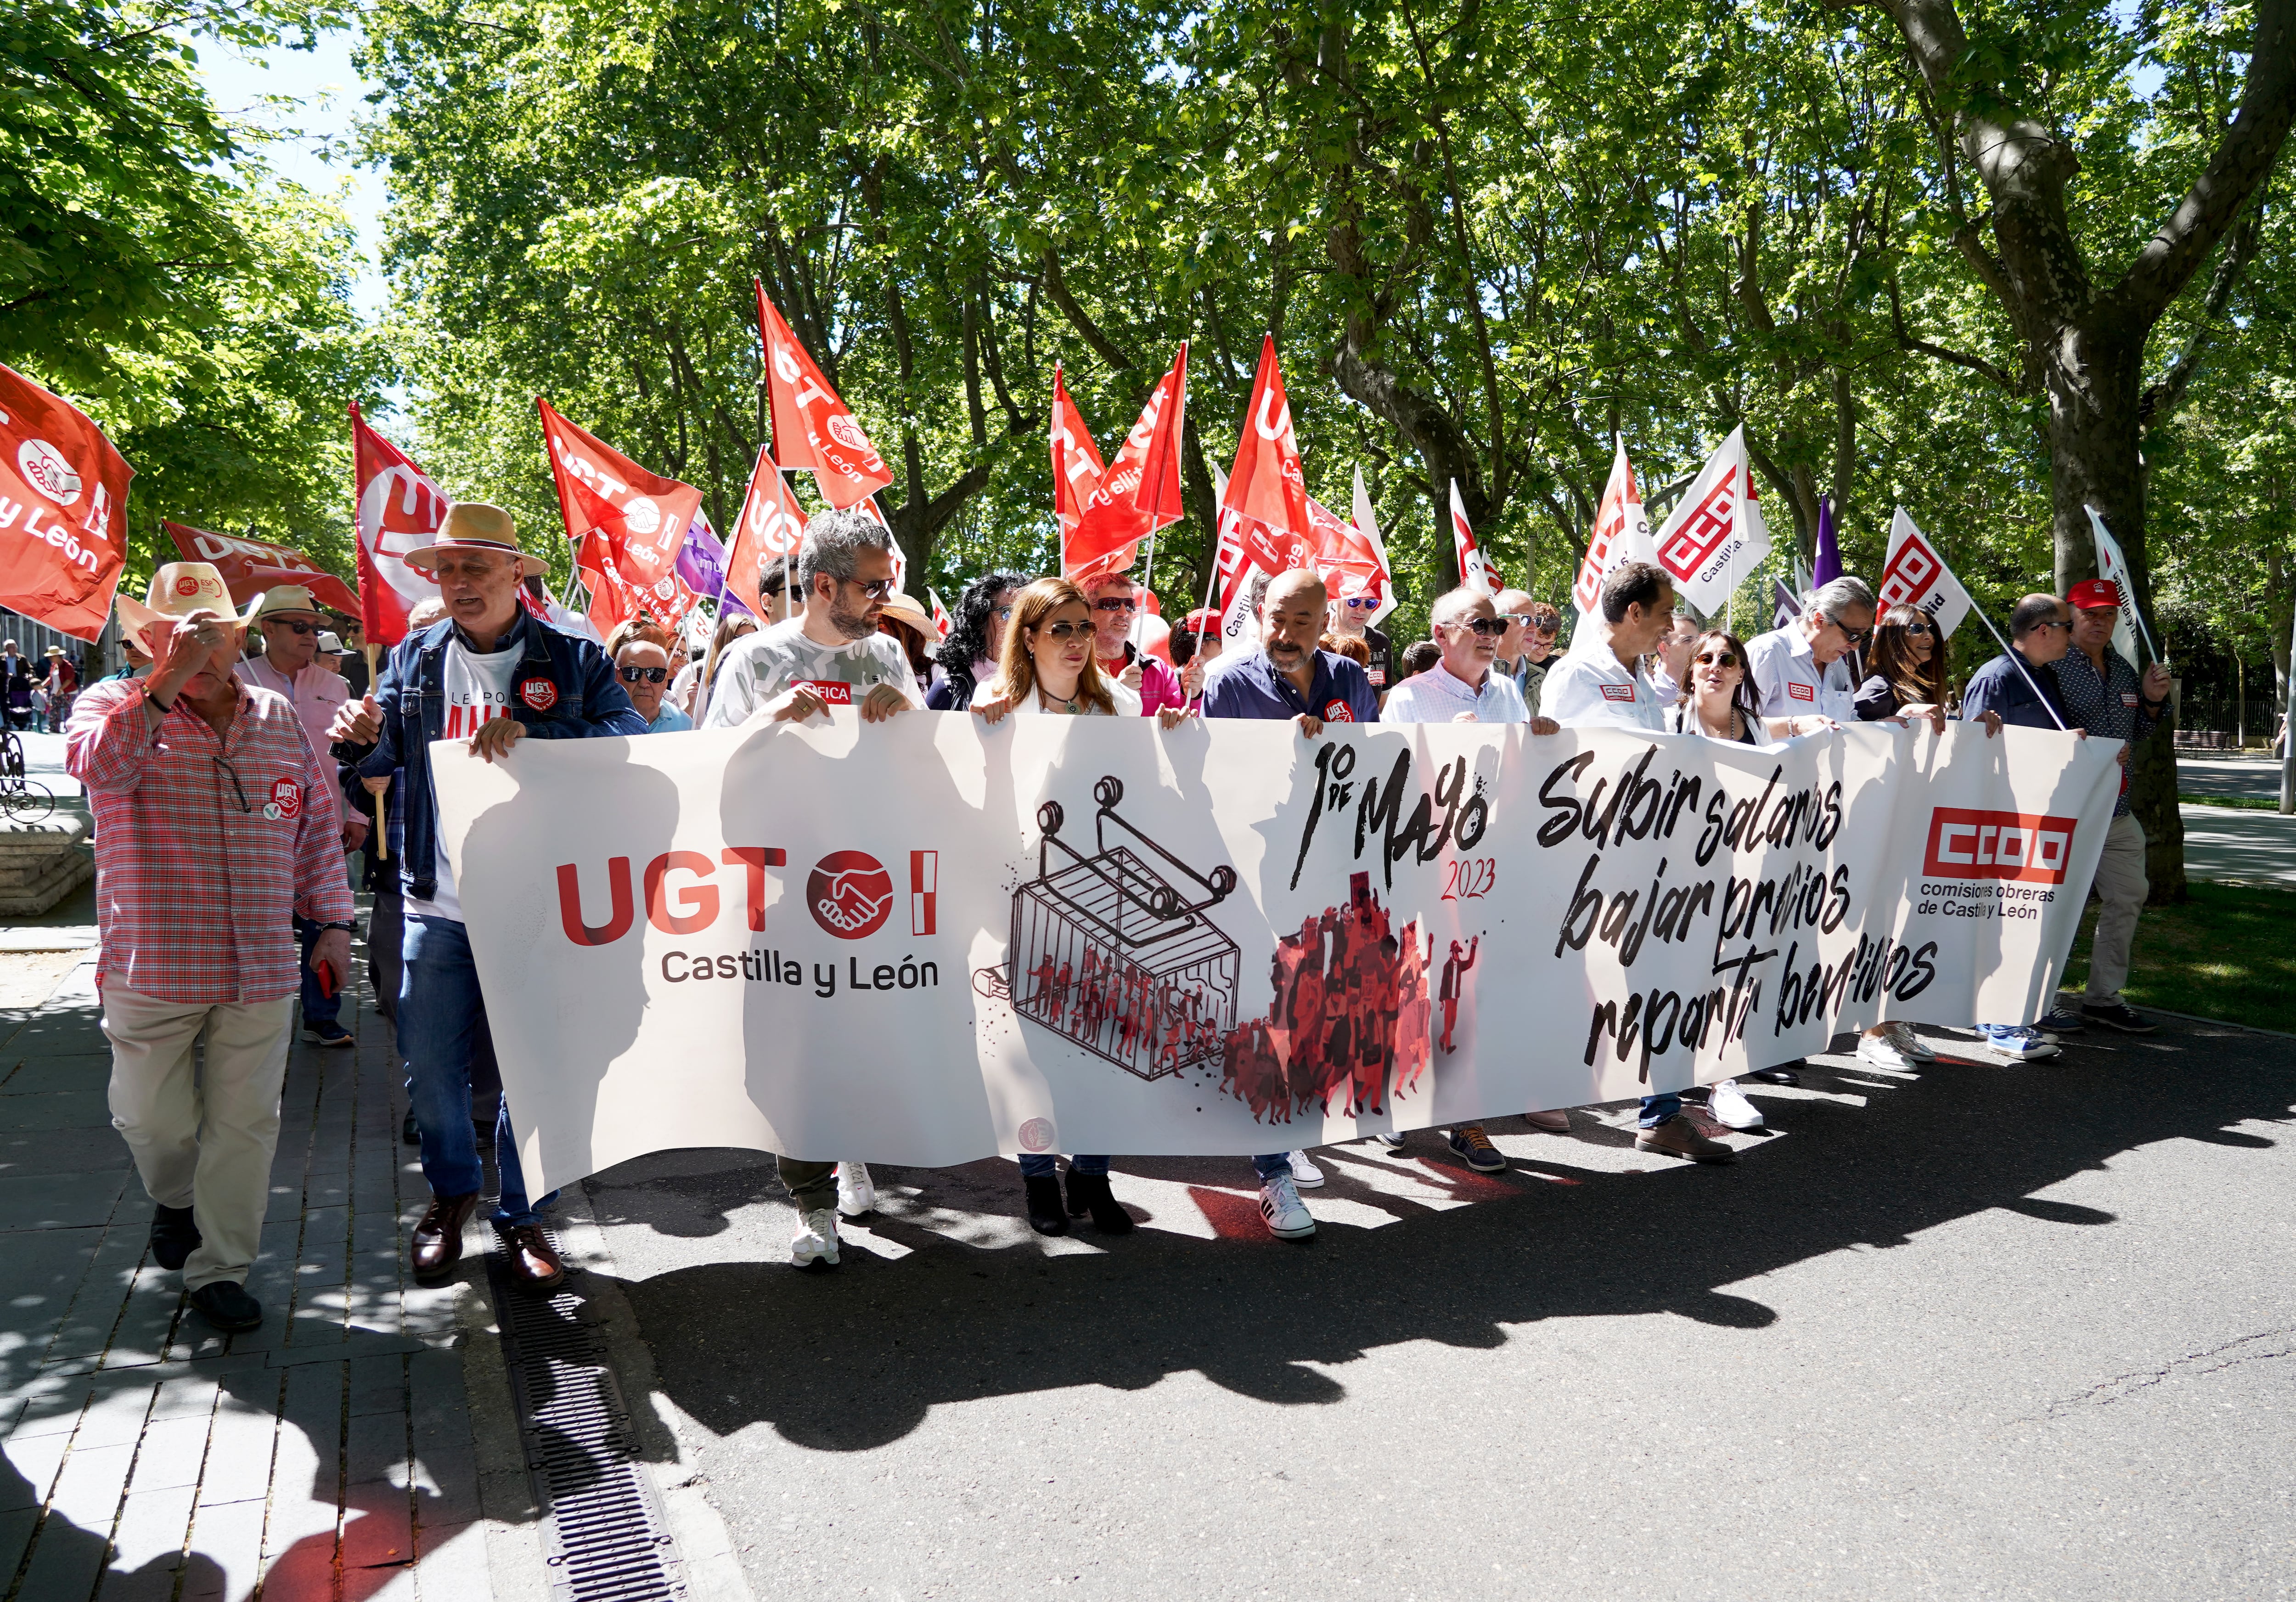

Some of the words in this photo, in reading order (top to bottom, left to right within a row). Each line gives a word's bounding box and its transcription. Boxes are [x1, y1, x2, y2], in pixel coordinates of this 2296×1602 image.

[820, 444, 864, 483] León
[24, 507, 98, 572] León
[1665, 476, 1736, 570] CCO
[624, 536, 660, 565] León
[1701, 540, 1743, 583] Castilla
[650, 599, 670, 625] León
[451, 692, 469, 704] LE
[526, 682, 551, 694] UGT
[817, 687, 849, 700] FICA
[1327, 701, 1346, 718] UGT
[276, 783, 298, 798] UGT
[1328, 780, 1354, 812] DE
[1536, 743, 1702, 848] Subir
[1936, 822, 2069, 871] CCOO
[556, 847, 787, 946] UGT
[1441, 857, 1496, 902] 2023
[1920, 883, 1992, 899] comisiones
[1996, 885, 2054, 903] obreras
[1554, 853, 1715, 967] bajar
[1918, 899, 1937, 914] de
[1942, 900, 1986, 919] Castilla
[1986, 905, 1994, 919] y
[1998, 902, 2037, 920] León
[661, 949, 801, 986] Castilla
[813, 963, 835, 998] y
[850, 954, 939, 990] León
